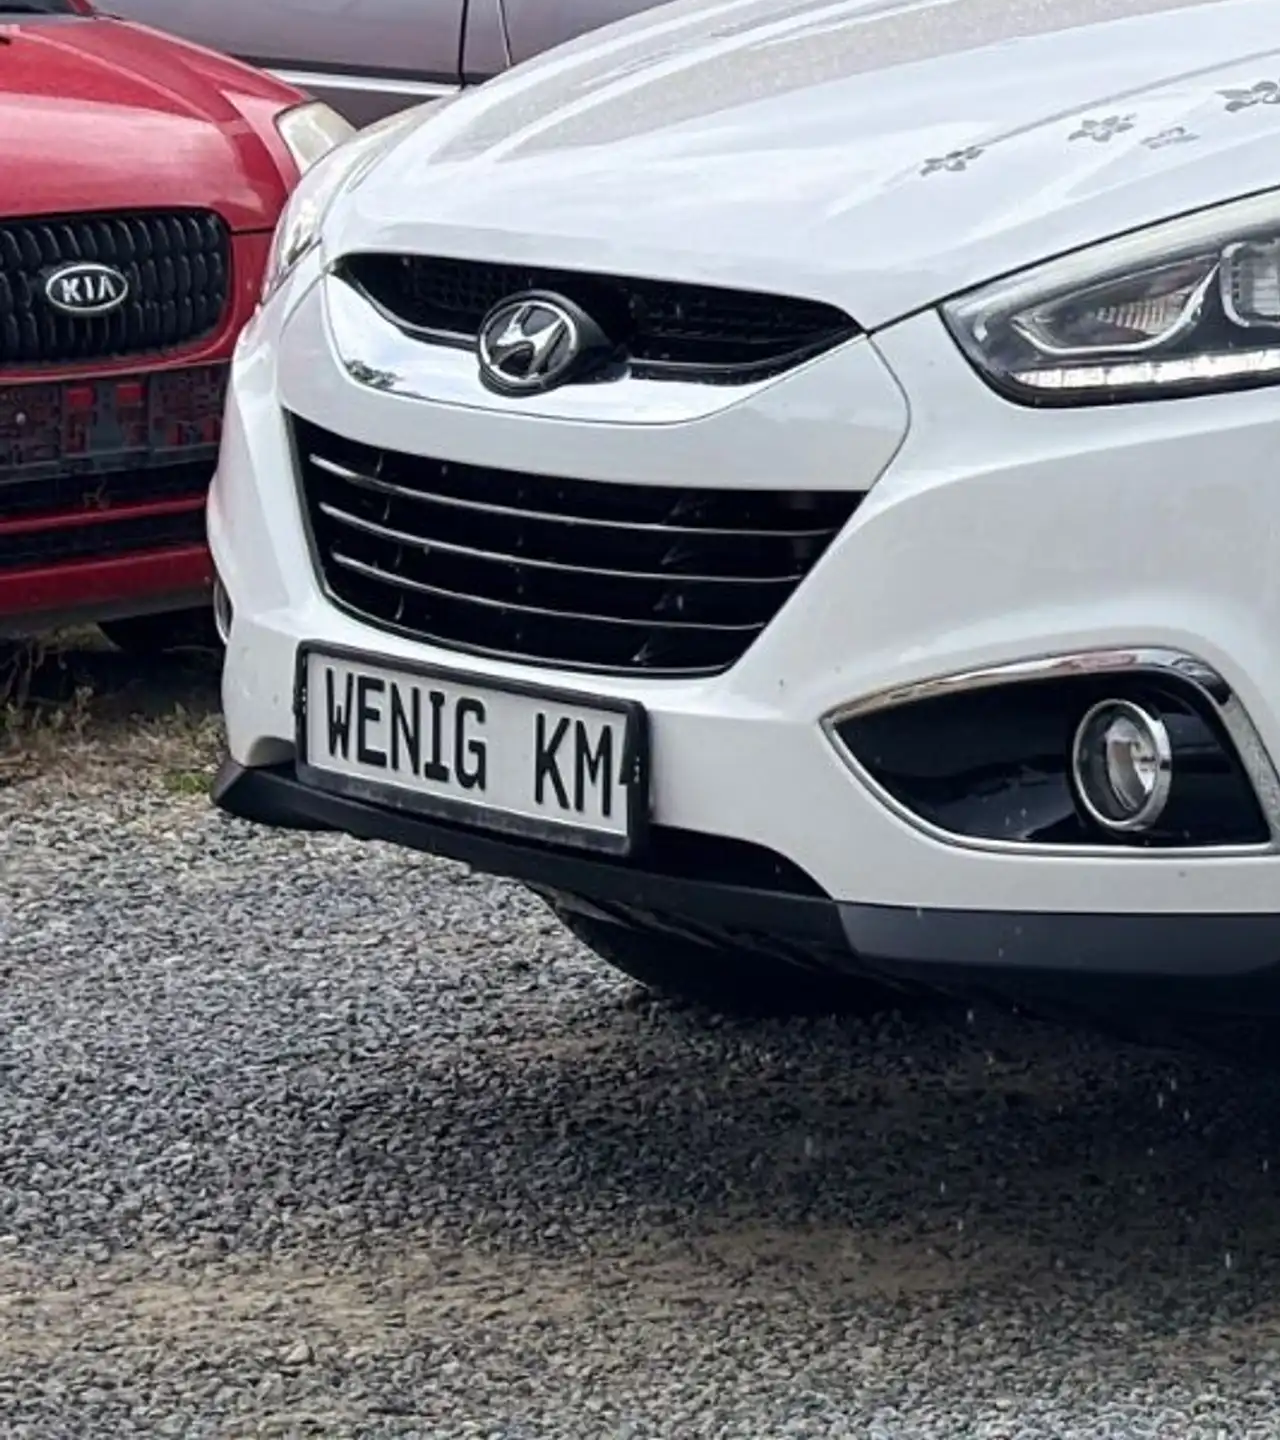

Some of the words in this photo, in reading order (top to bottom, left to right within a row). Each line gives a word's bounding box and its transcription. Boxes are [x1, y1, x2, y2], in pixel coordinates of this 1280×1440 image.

[60, 275, 116, 302] KIA
[326, 667, 486, 791] WENIG
[535, 712, 612, 817] KM
